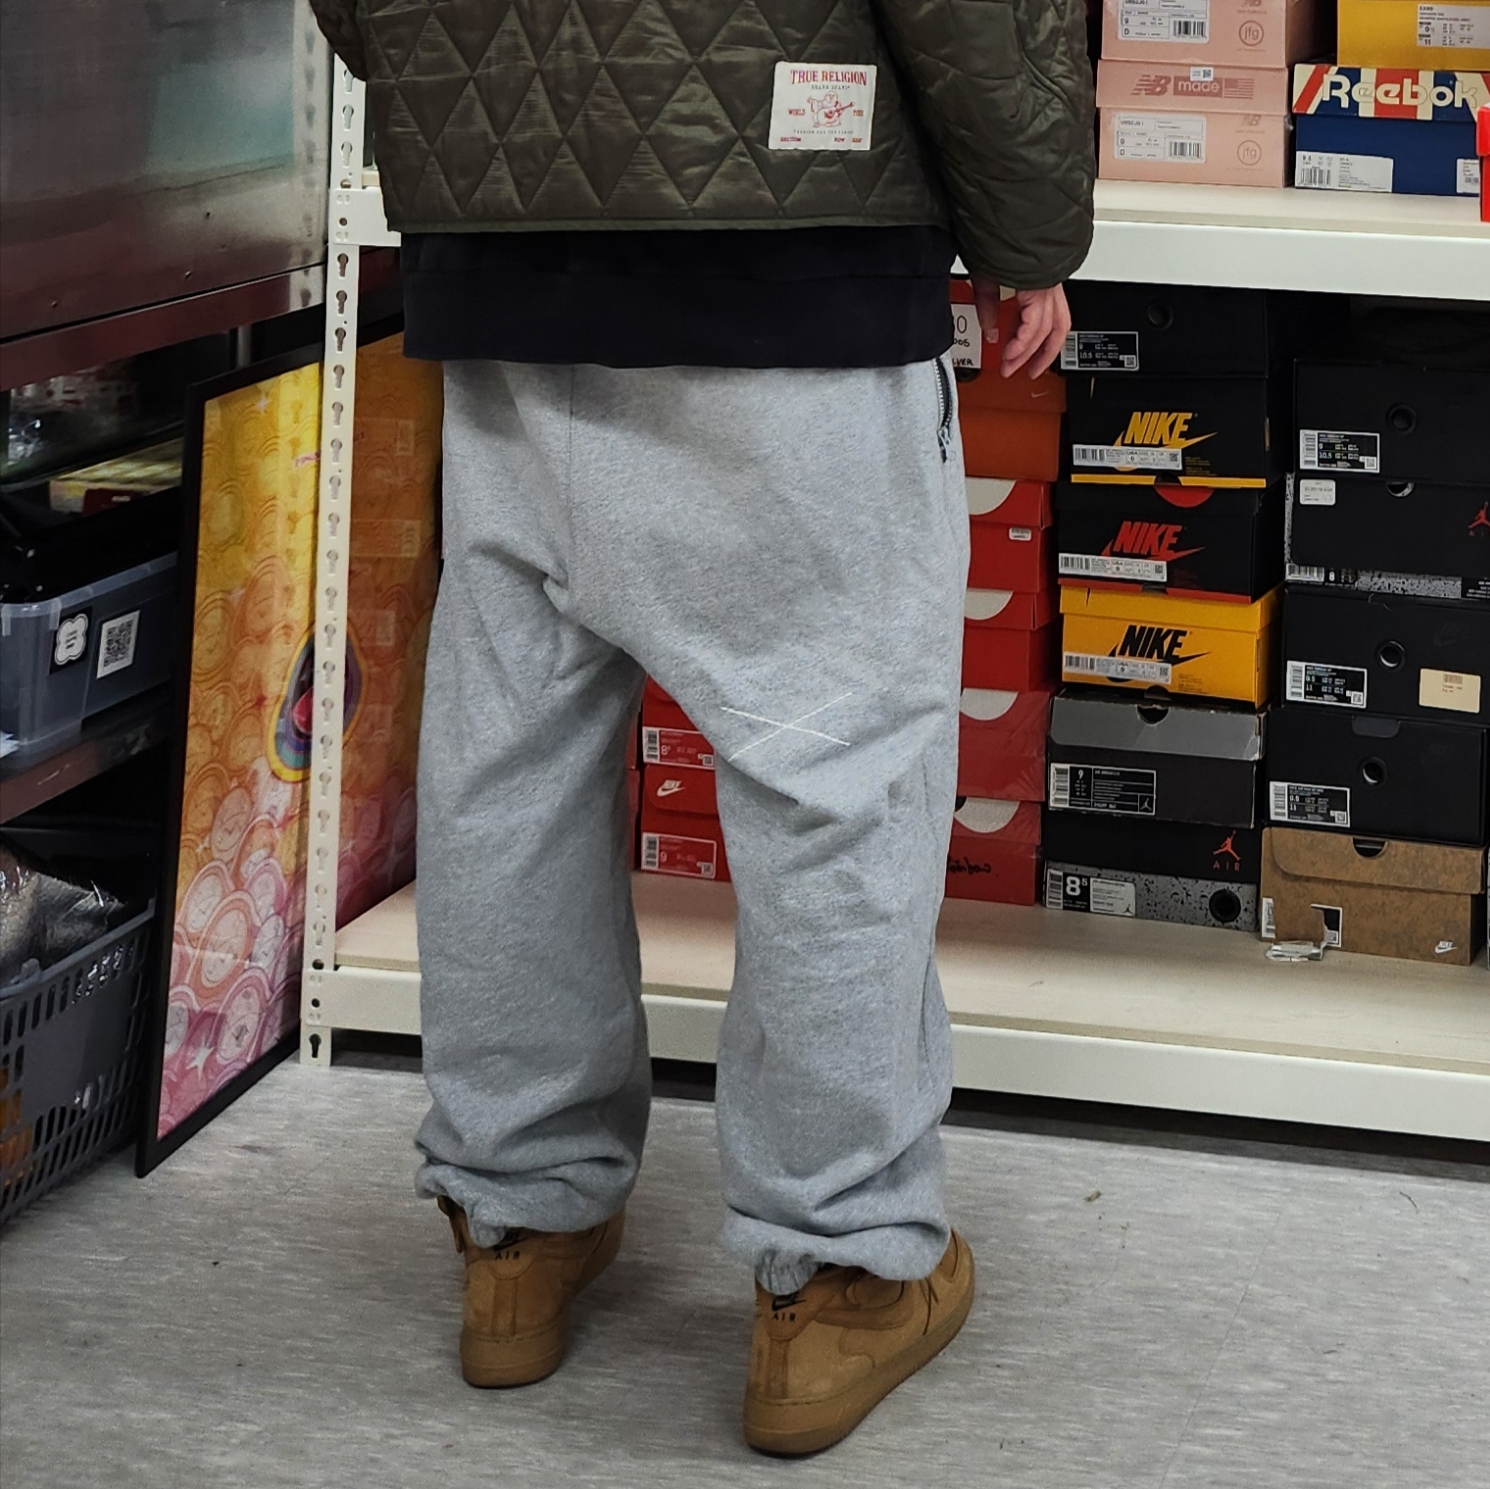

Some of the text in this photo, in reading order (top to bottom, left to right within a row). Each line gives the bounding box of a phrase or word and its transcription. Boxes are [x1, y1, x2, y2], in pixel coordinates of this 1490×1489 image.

[1243, 24, 1260, 42] jfg
[791, 70, 867, 86] TRUE RELIGION
[1177, 79, 1220, 94] made
[1322, 73, 1478, 108] Reebok
[1242, 144, 1258, 160] jfg
[1124, 412, 1193, 445] NIKE
[1113, 521, 1183, 554] NIKE
[1119, 624, 1188, 661] NIKE
[1078, 769, 1084, 779] 9
[1212, 861, 1240, 871] AIR
